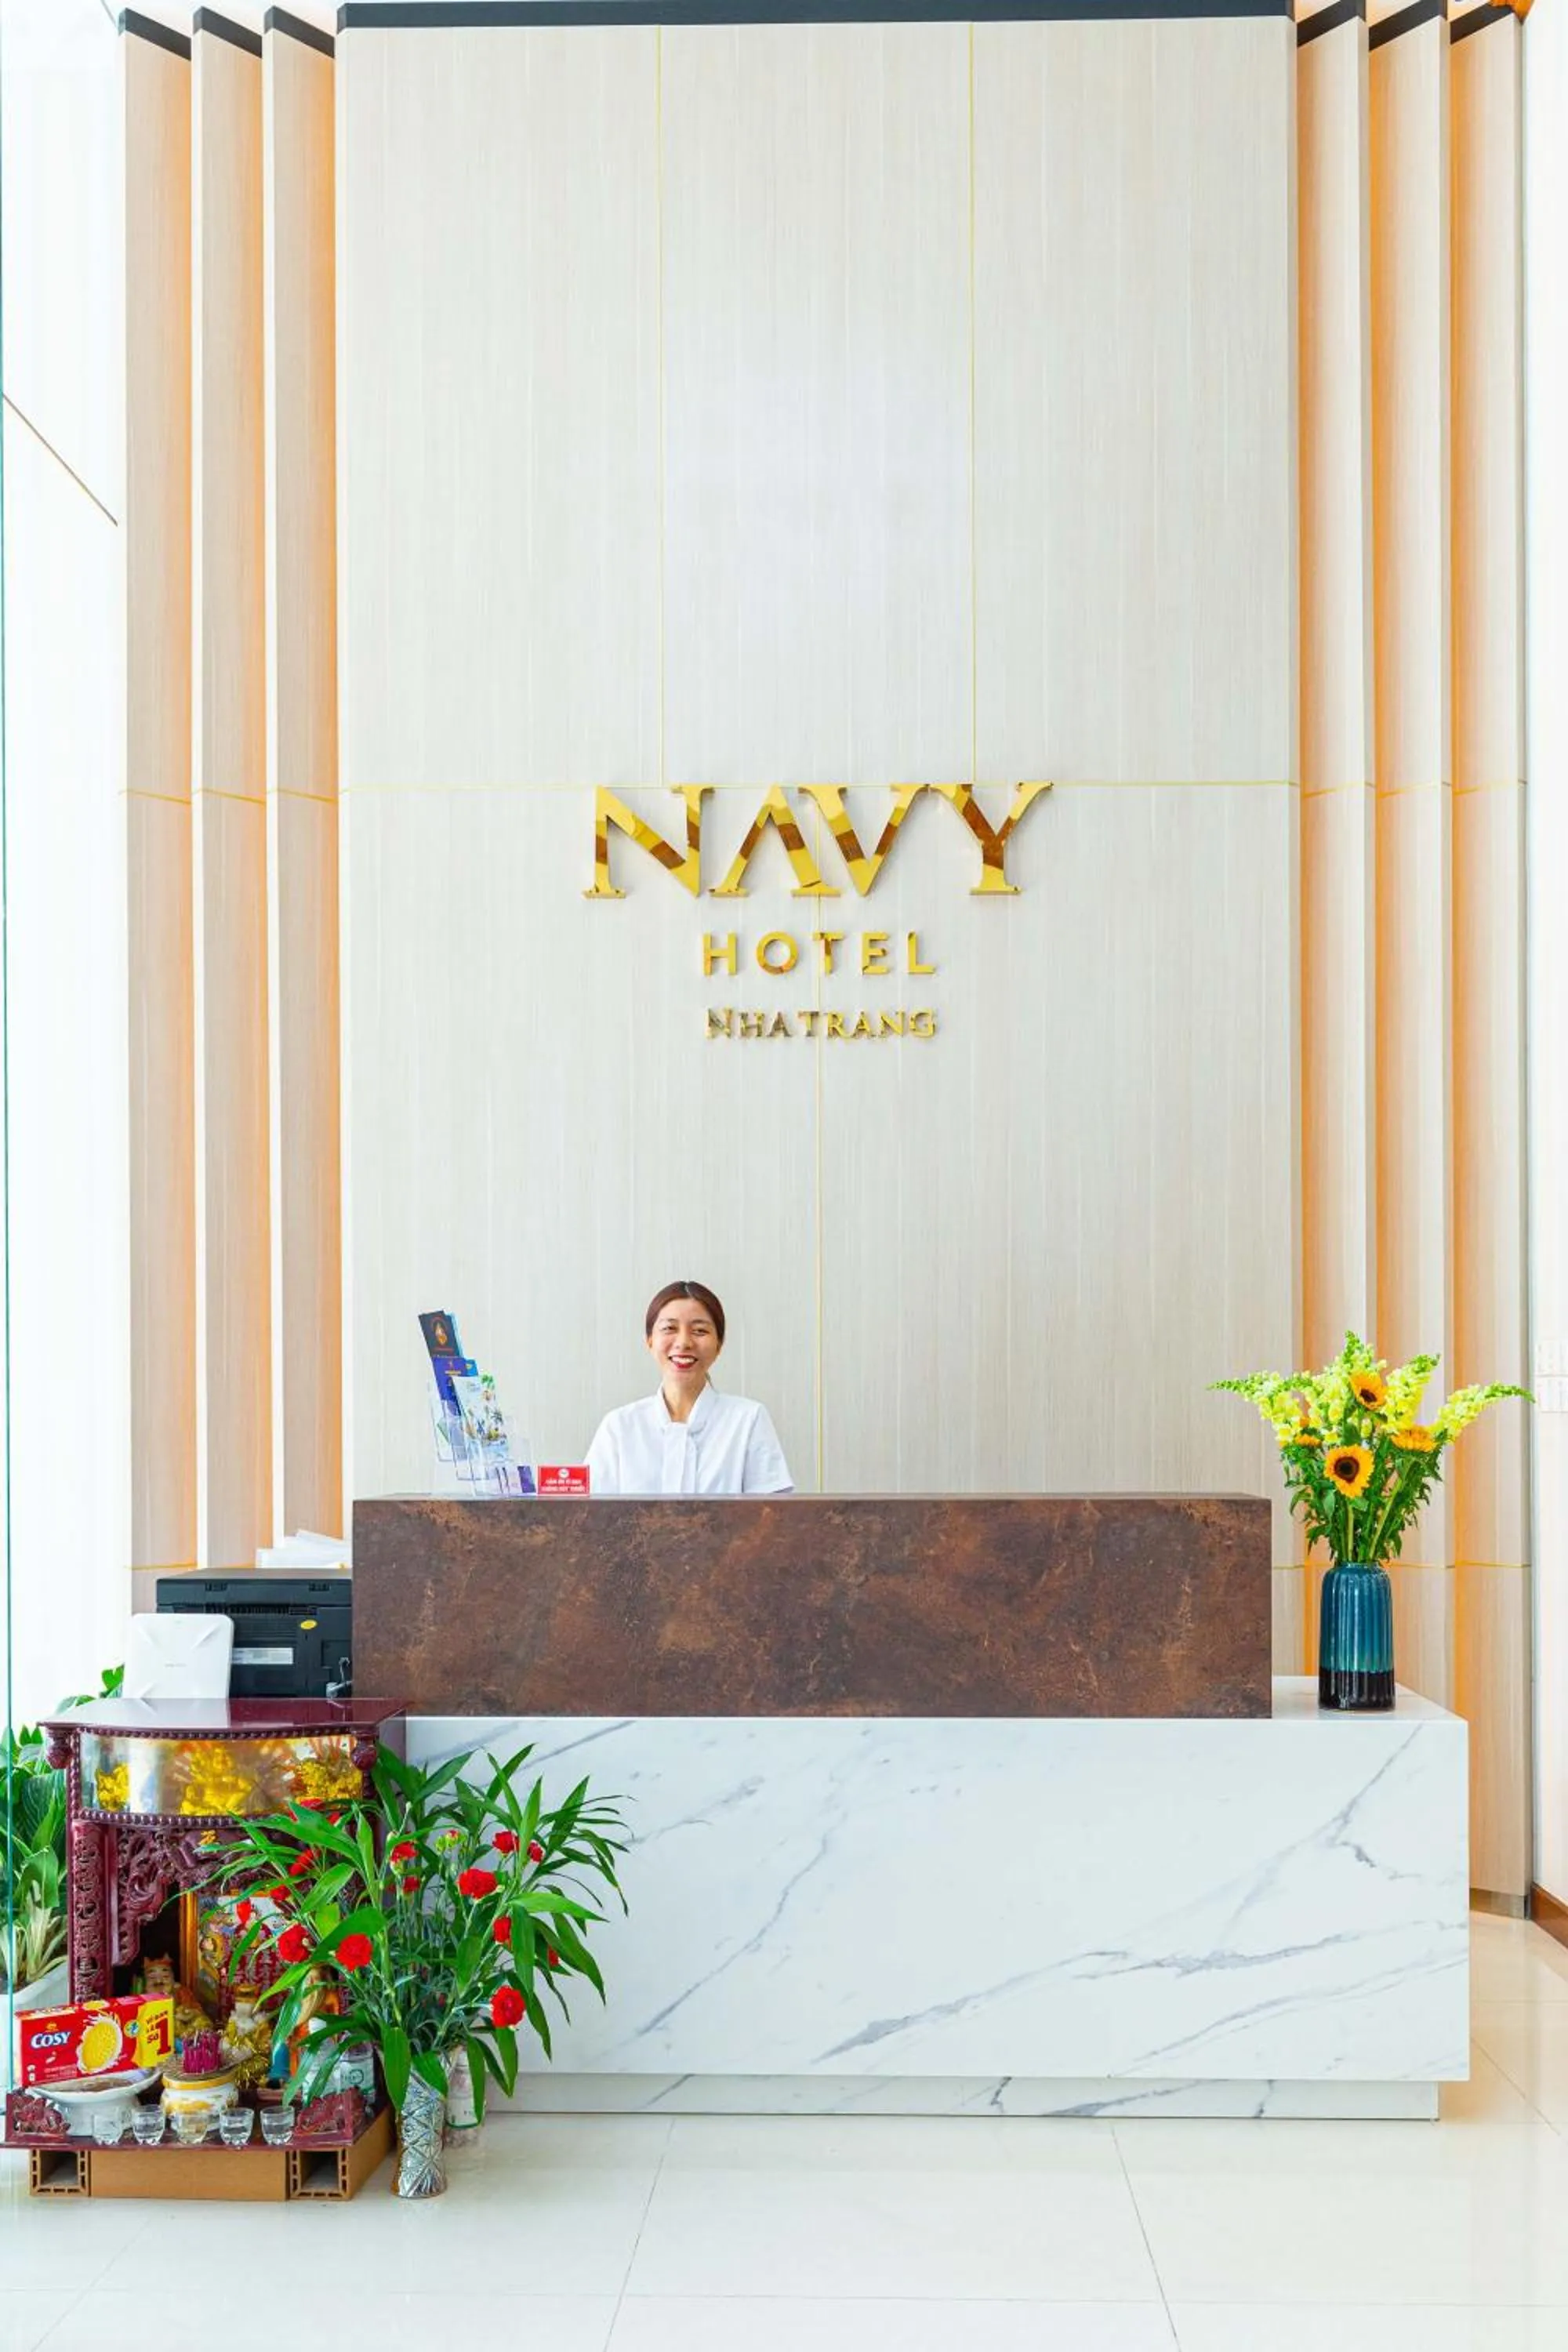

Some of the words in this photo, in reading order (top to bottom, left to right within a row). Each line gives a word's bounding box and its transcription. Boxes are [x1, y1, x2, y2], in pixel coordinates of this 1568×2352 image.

[582, 782, 1054, 898] NAVY
[702, 931, 937, 976] HOTEL
[30, 2031, 71, 2049] COSY
